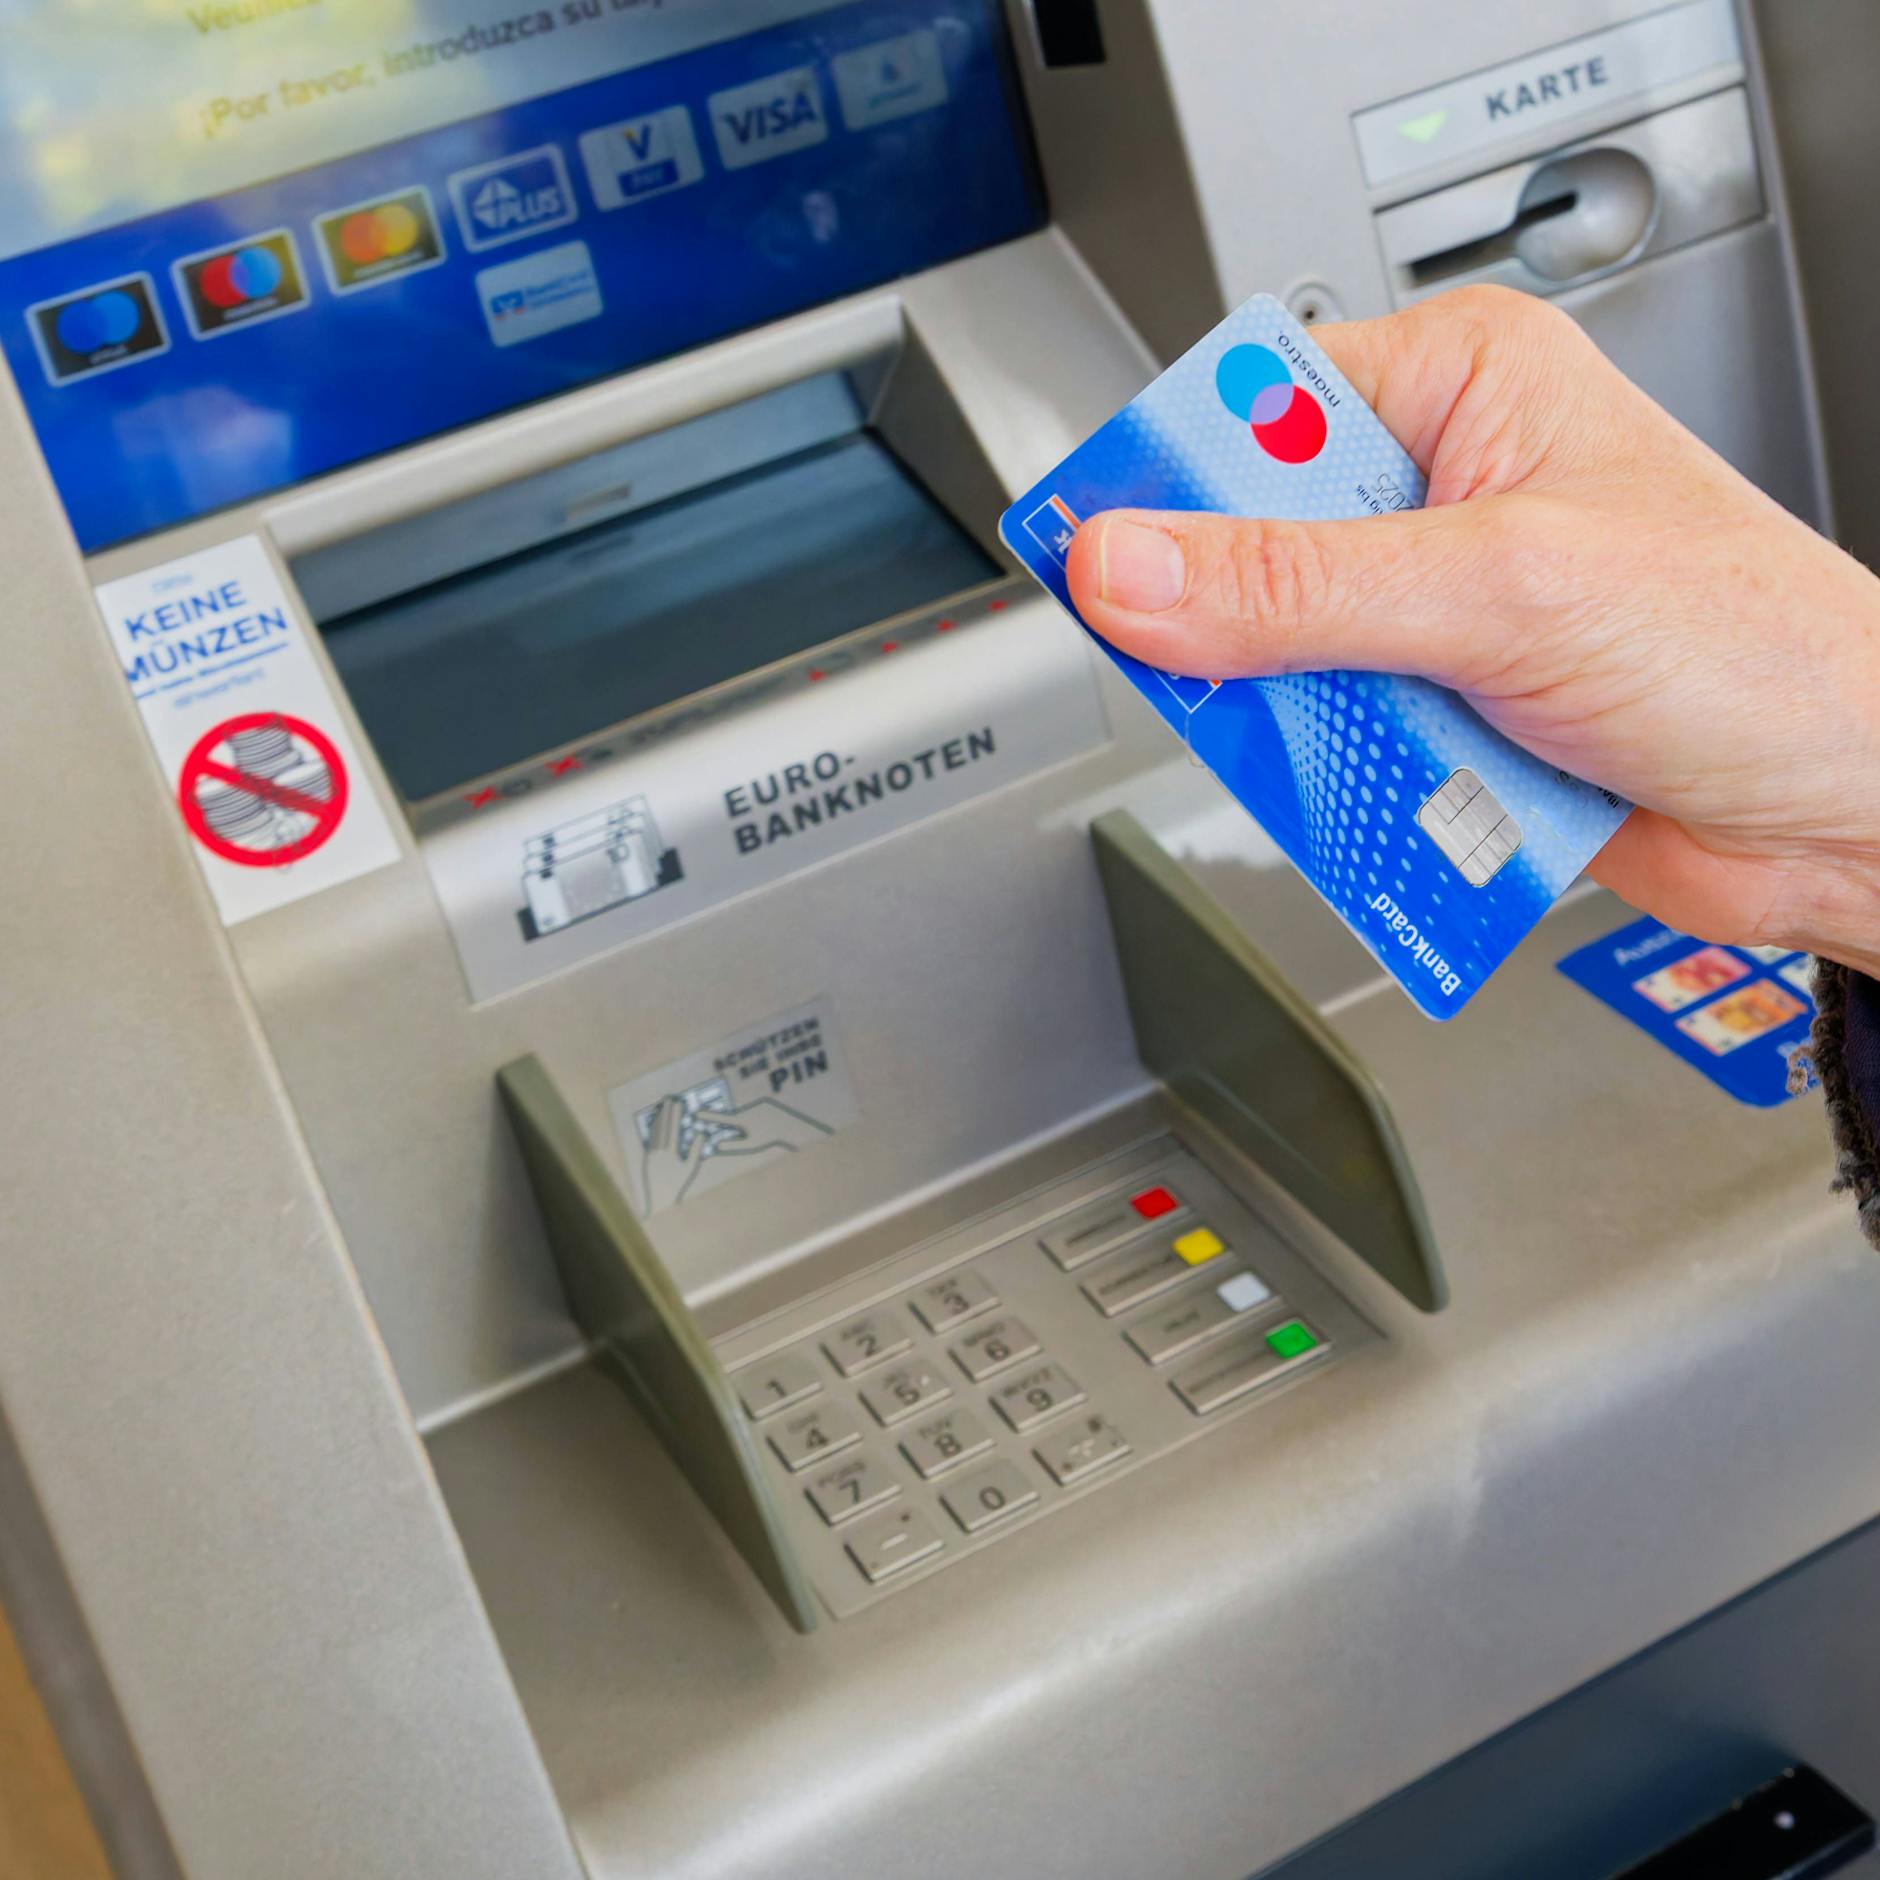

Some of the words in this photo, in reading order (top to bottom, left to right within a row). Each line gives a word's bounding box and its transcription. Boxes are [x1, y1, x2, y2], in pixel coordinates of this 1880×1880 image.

[381, 10, 555, 78] introduzca
[1485, 57, 1610, 121] KARTE
[725, 91, 817, 144] VISA
[625, 124, 649, 160] V
[124, 581, 246, 641] KEINE
[126, 607, 288, 682] MÜNZEN
[723, 750, 857, 819] EURO-
[734, 726, 996, 856] BANKNOTEN
[1370, 893, 1462, 997] BankCard
[769, 1050, 828, 1093] PIN
[944, 1293, 970, 1316] 3
[857, 1334, 881, 1357] 2
[984, 1339, 1009, 1361] 6
[767, 1378, 787, 1398] 1
[894, 1381, 921, 1405] 5
[1027, 1388, 1052, 1412] 9
[806, 1428, 830, 1449] 4
[934, 1434, 962, 1459] 8
[839, 1478, 860, 1504] 7
[979, 1486, 1005, 1511] 0
